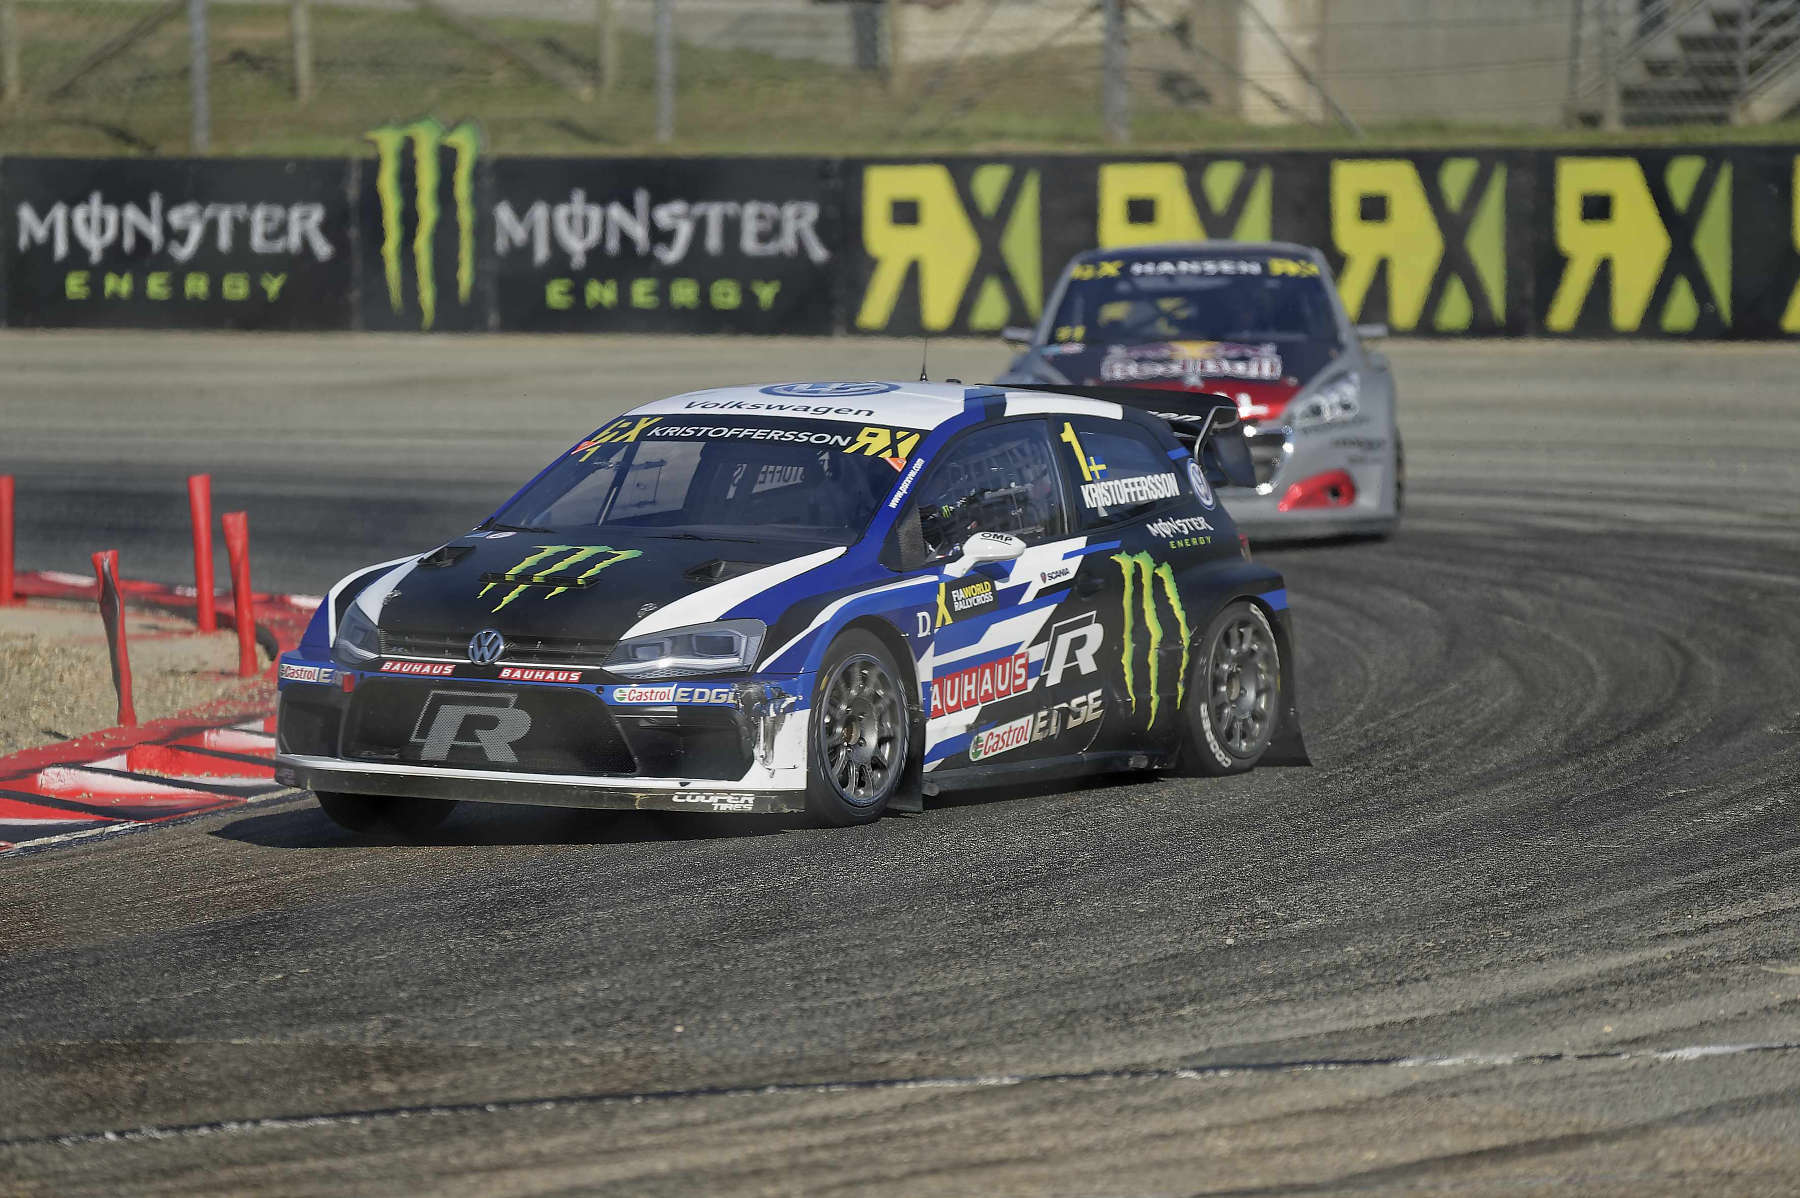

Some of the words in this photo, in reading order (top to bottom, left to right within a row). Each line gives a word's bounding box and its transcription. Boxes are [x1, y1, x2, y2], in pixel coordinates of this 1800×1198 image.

[17, 190, 336, 264] MONSTER
[493, 187, 831, 271] MONSTER
[855, 163, 1044, 331] RX
[1330, 157, 1508, 331] RX
[1545, 156, 1734, 332] RX
[1130, 259, 1262, 276] HANSEN
[65, 270, 289, 301] ENERGY
[545, 278, 782, 310] ENERGY
[684, 400, 875, 417] Volkswagen
[646, 426, 852, 447] KRISTOFFERSSON
[1080, 472, 1180, 509] KRISTOFFERSSON
[981, 532, 1013, 542] OMP
[1146, 516, 1214, 539] MONSTER
[1168, 536, 1212, 549] ENERGY
[1047, 567, 1070, 581] SCANIA
[953, 592, 993, 612] RALLYCROSS
[285, 665, 317, 681] Castrol
[381, 661, 456, 674] BAUHAUS
[501, 668, 582, 681] BAUHAUS
[627, 688, 671, 702] Castrol
[984, 719, 1030, 756] Castrol
[672, 791, 755, 804] COOPER
[712, 803, 754, 811] TIRES
